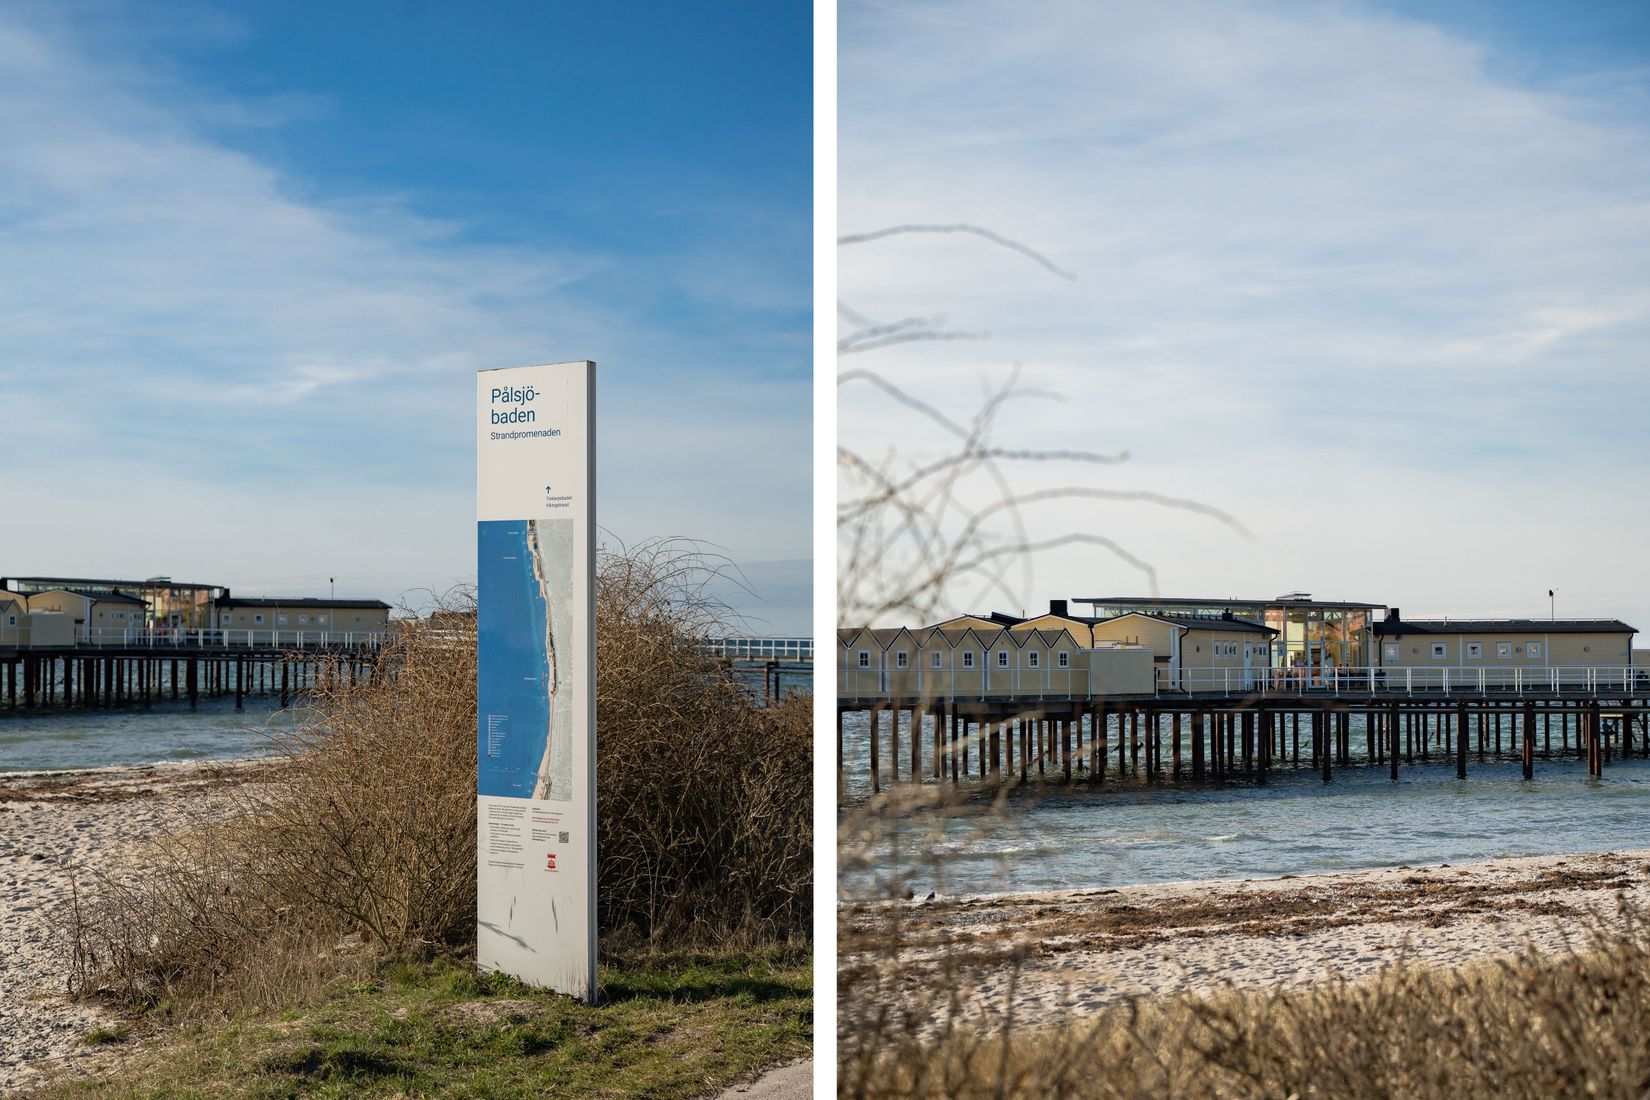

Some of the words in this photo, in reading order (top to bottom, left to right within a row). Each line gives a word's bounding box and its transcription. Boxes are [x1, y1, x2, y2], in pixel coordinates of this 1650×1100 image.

[491, 385, 540, 405] Pålsjö-
[491, 408, 535, 424] baden
[490, 428, 561, 440] Strandpromenaden
